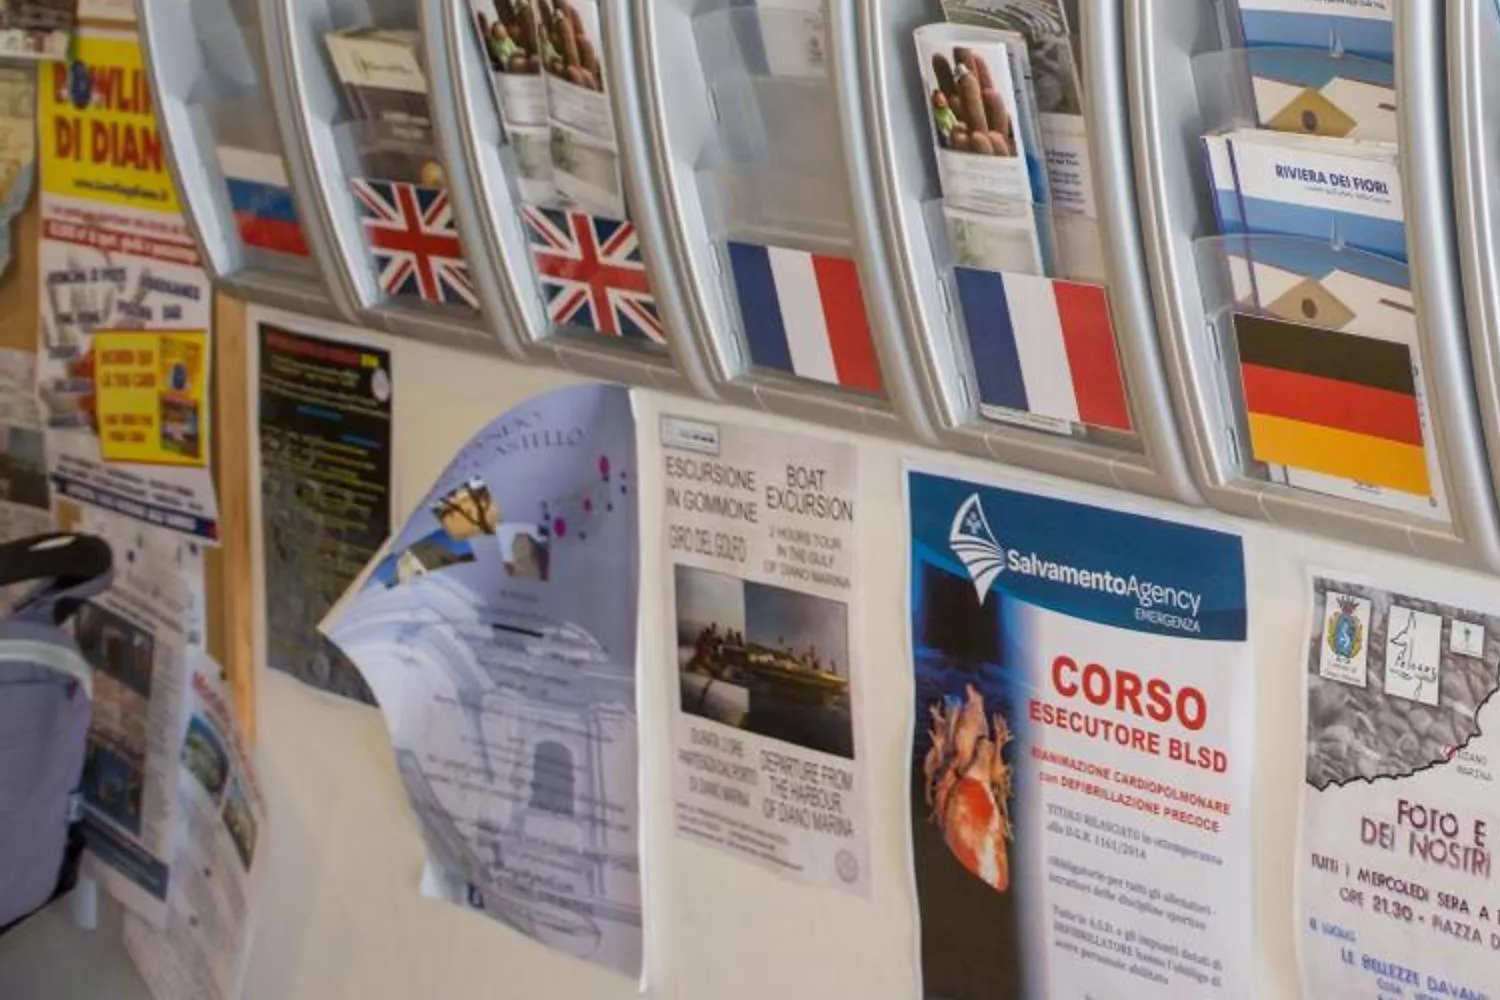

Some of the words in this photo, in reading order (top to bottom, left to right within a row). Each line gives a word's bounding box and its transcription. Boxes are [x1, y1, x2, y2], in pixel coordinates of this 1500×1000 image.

[55, 116, 82, 161] DI
[92, 120, 163, 174] DIAN
[1276, 164, 1328, 186] RIVIERA
[1328, 173, 1351, 189] DEI
[1352, 177, 1389, 195] FIORI
[665, 455, 757, 493] ESCURSIONE
[786, 464, 827, 492] BOAT
[666, 487, 681, 510] IN
[683, 490, 759, 524] GOMMONE
[766, 485, 854, 522] EXCURSION
[1007, 549, 1202, 617] SalvamentoAgency
[1134, 607, 1201, 633] EMERGENZA
[1051, 654, 1208, 732] CORSO
[1028, 698, 1161, 755] ESECUTORE
[1168, 736, 1229, 774] BLSD
[1060, 775, 1160, 816] DEFIBRILLAZIONE
[1162, 805, 1221, 833] PRECOCE
[1114, 771, 1231, 815] CARDIOPOLMONARE
[1397, 797, 1459, 838] FOTO
[1474, 819, 1487, 848] E
[1437, 890, 1470, 914] SERA
[1479, 906, 1491, 922] A
[1431, 913, 1483, 945] PIAZZA
